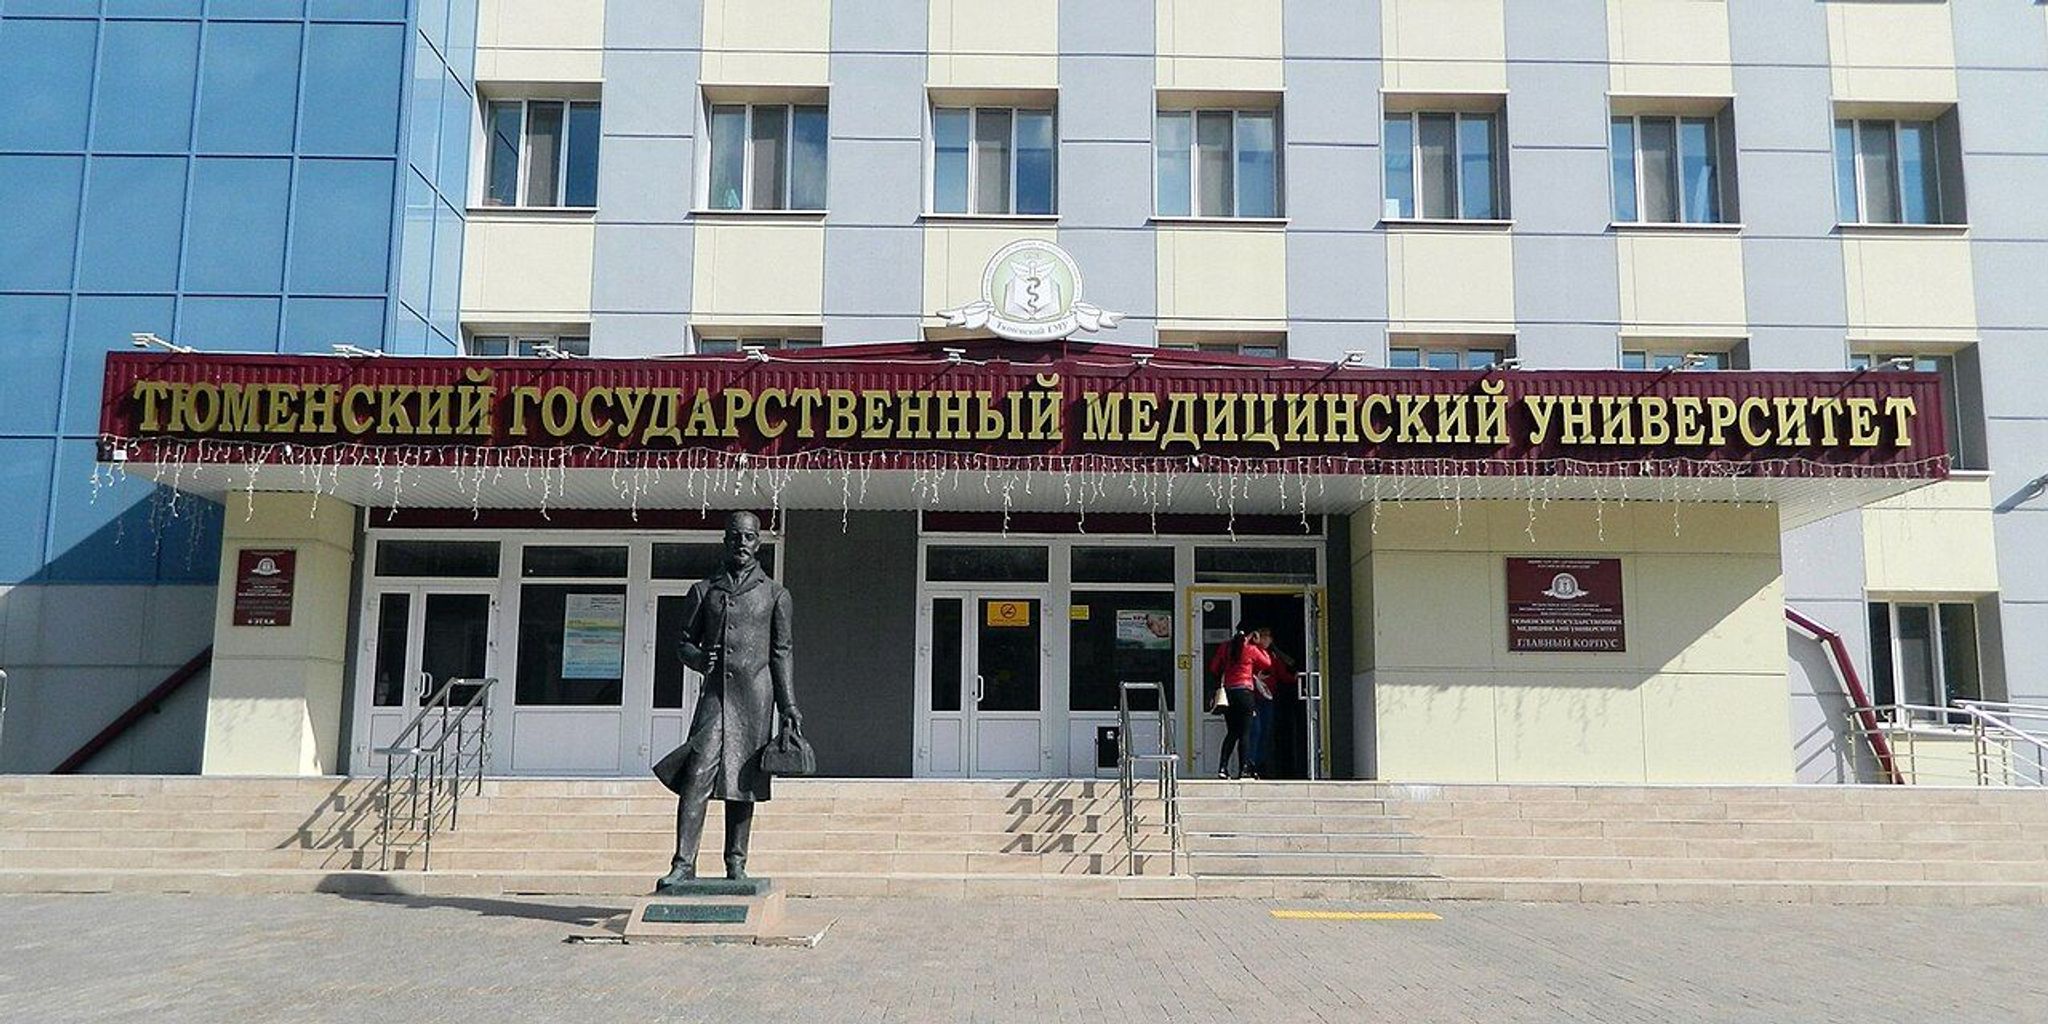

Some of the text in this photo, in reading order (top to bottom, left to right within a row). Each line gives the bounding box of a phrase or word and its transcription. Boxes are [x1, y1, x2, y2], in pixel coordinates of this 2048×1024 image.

[133, 367, 1918, 451] ТЮМЕНСКИЙ ГОСУДАРСТВЕННЫЙ МЕДИЦИНСКИЙ УНИВЕРСИТЕТ
[1517, 637, 1619, 649] ГЛАВНЫЙ КОРПУС
